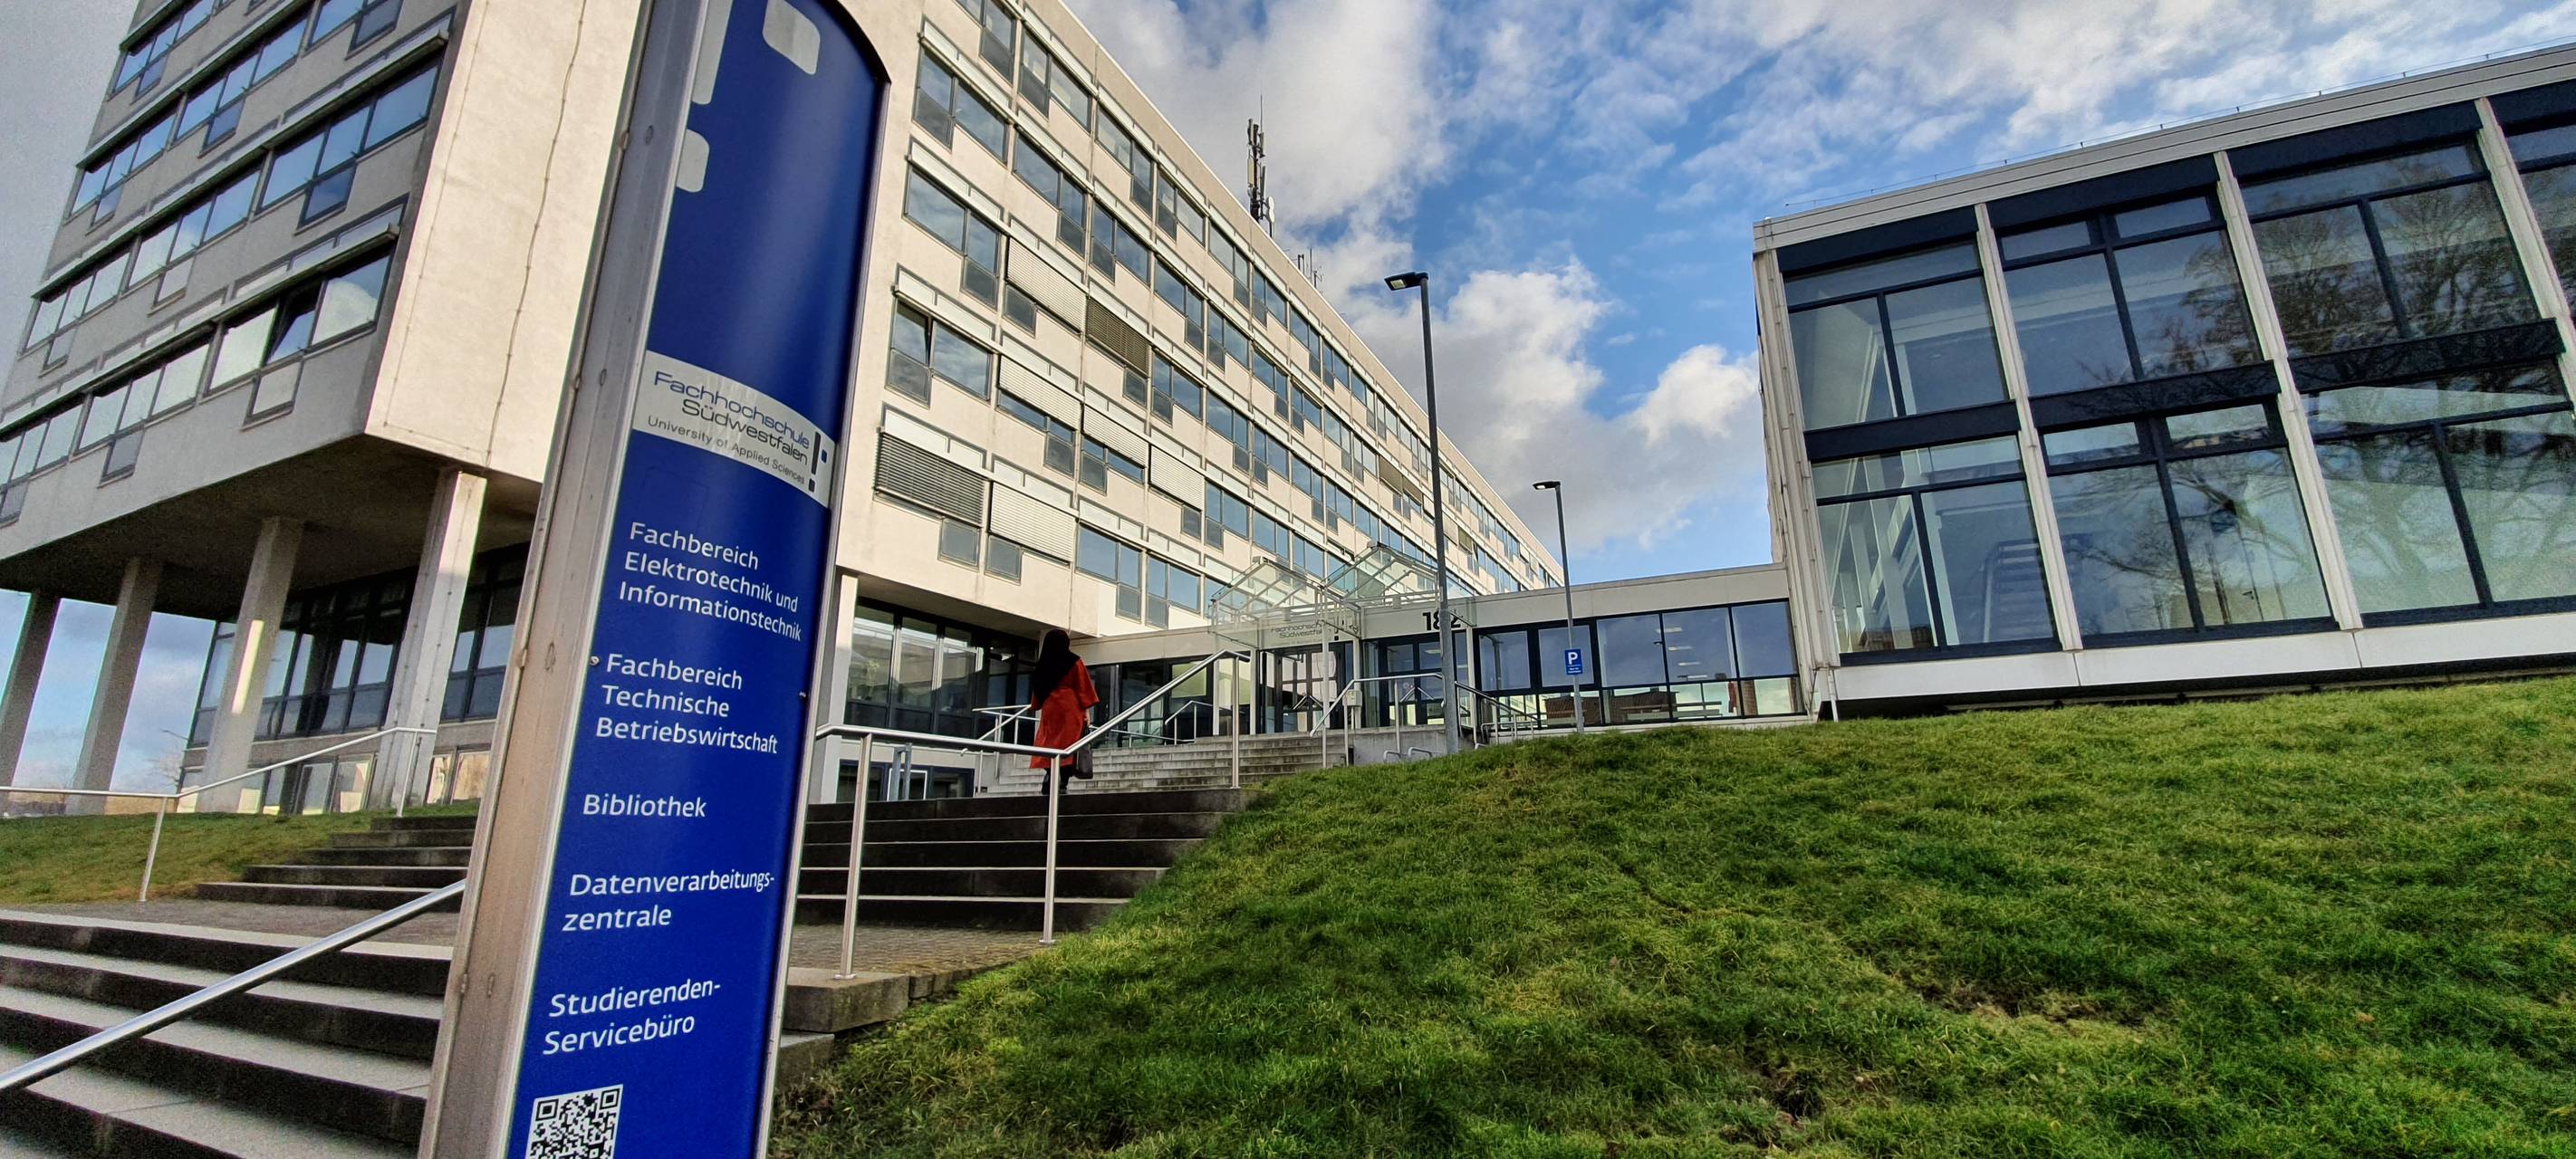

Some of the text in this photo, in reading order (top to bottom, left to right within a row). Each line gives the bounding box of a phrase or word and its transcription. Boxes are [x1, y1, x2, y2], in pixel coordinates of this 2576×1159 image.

[654, 371, 810, 449] Fachhochschule
[648, 416, 805, 484] University of Applied Sciences
[682, 399, 808, 465] Südwestfalen
[630, 522, 759, 570] Fachbereich
[625, 551, 799, 613] Elektrotechnik und
[620, 581, 802, 642] Informationstechnik
[606, 653, 743, 690] Fachbereich
[1568, 652, 1578, 665] P
[601, 685, 730, 717] Technische
[596, 716, 778, 754] Betriebswirtschaft
[582, 793, 706, 818] Bibliothek
[570, 868, 774, 896] Datenverarbeitungs-
[562, 905, 672, 932] zentrale
[549, 978, 720, 1018] Studierenden-
[543, 1013, 695, 1055] Servicebüro
